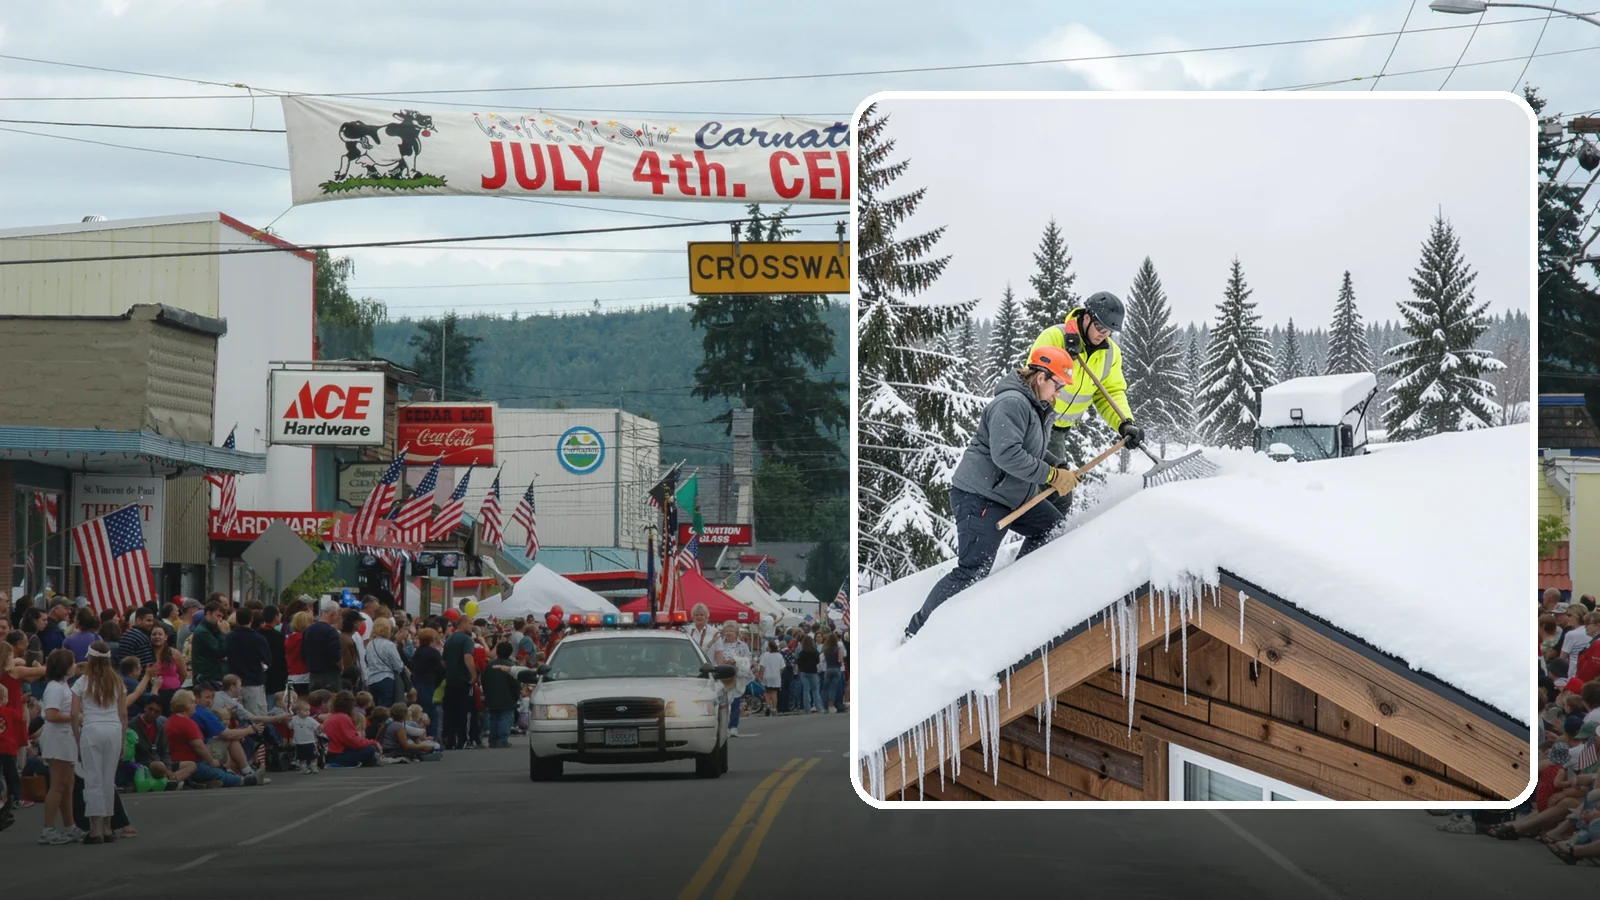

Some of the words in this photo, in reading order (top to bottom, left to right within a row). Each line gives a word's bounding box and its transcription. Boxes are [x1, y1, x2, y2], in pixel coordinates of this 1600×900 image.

[481, 141, 604, 192] JULY
[632, 150, 747, 197] 4th.
[697, 254, 850, 281] CROSSWA
[283, 379, 373, 420] ACE
[405, 409, 453, 421] CEDAR
[461, 409, 486, 421] LOG
[284, 421, 371, 436] Hardware
[416, 428, 477, 447] Coca-Cola
[353, 467, 385, 479] Simpl
[83, 486, 93, 494] St.
[96, 486, 124, 495] Vincent
[126, 486, 136, 494] de
[138, 486, 155, 495] Paul
[212, 516, 331, 534] HARDARE
[688, 526, 742, 535] CRNATION
[699, 535, 730, 543] GLASS
